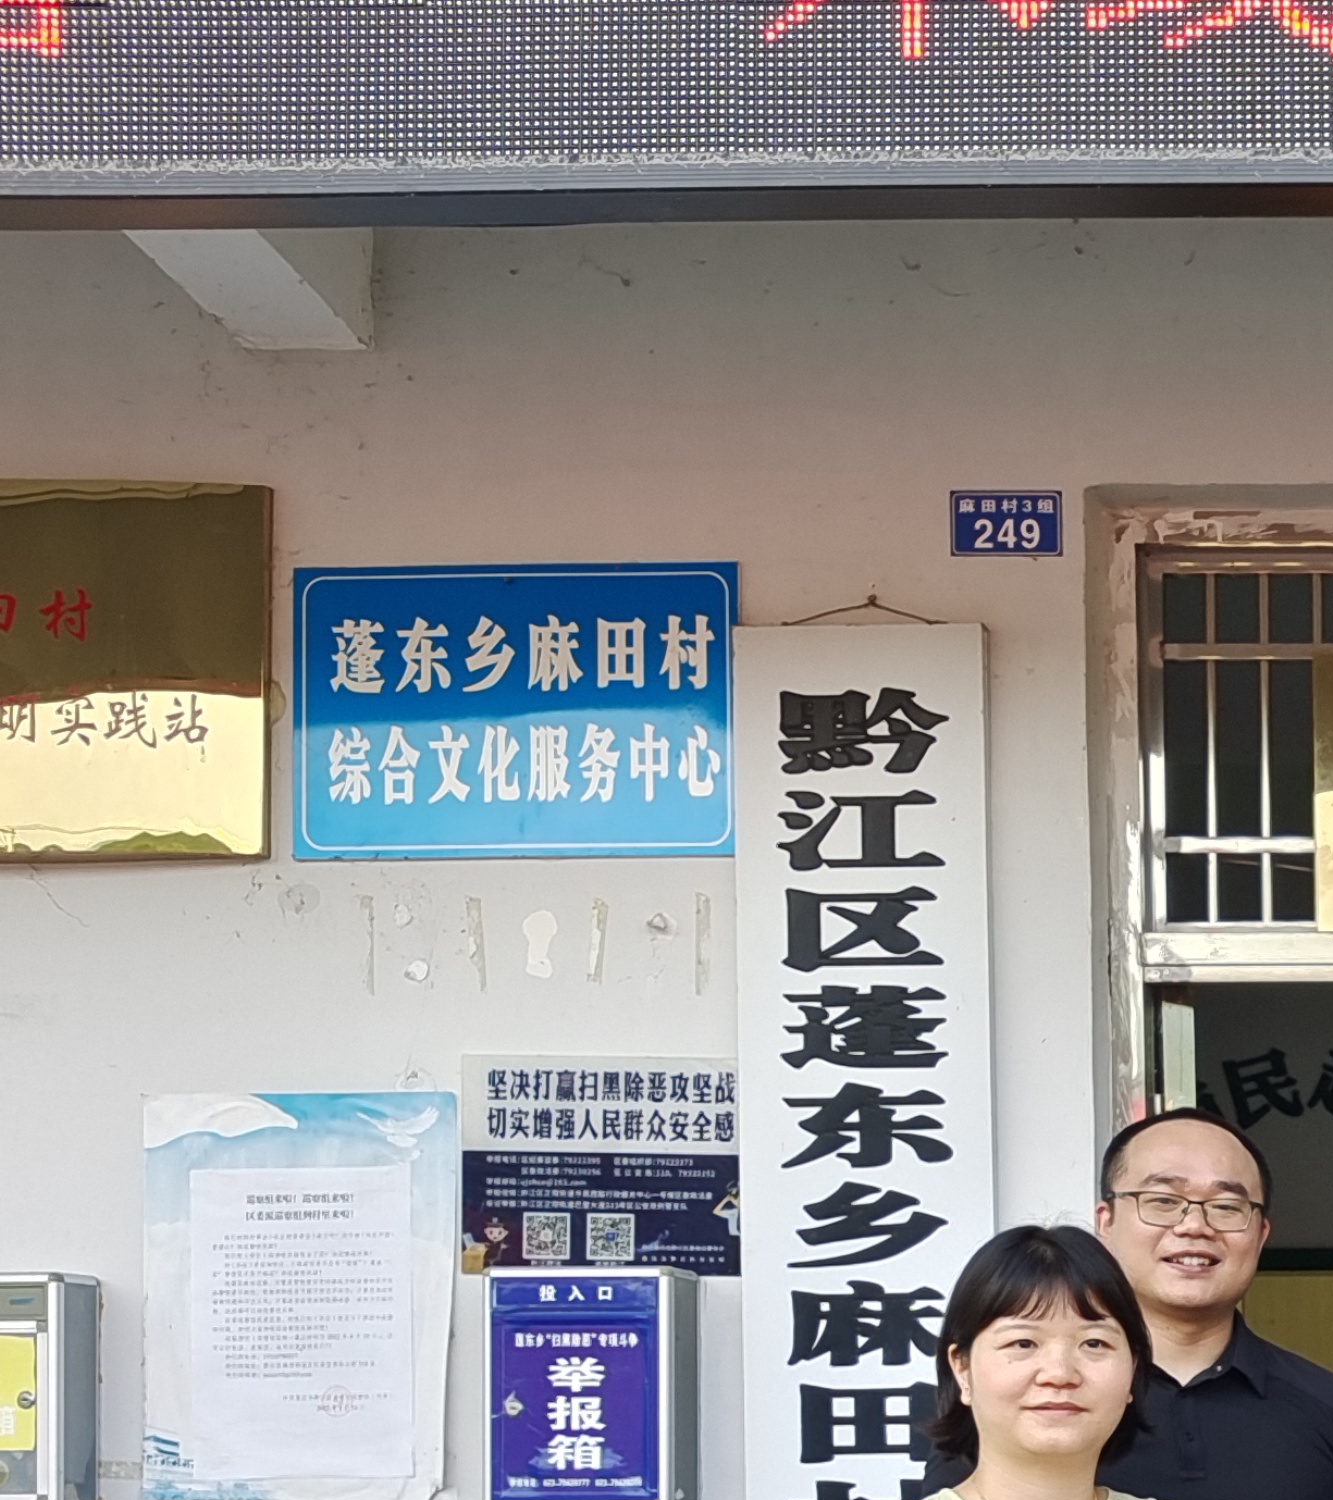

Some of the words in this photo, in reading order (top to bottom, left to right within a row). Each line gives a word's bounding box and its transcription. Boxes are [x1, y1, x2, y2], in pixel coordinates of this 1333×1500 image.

[959, 498, 1054, 513] 麻田村3组
[974, 519, 1040, 549] 249
[330, 615, 715, 694] 蓬东乡麻田村
[328, 724, 721, 805] 综合文化服务中心
[487, 1069, 736, 1104] 坚决打赢扫黑除恶攻坚战
[487, 1107, 735, 1141] 切实增强人民群众安全感
[539, 1284, 613, 1302] 投入口
[546, 1357, 607, 1470] 举报箱
